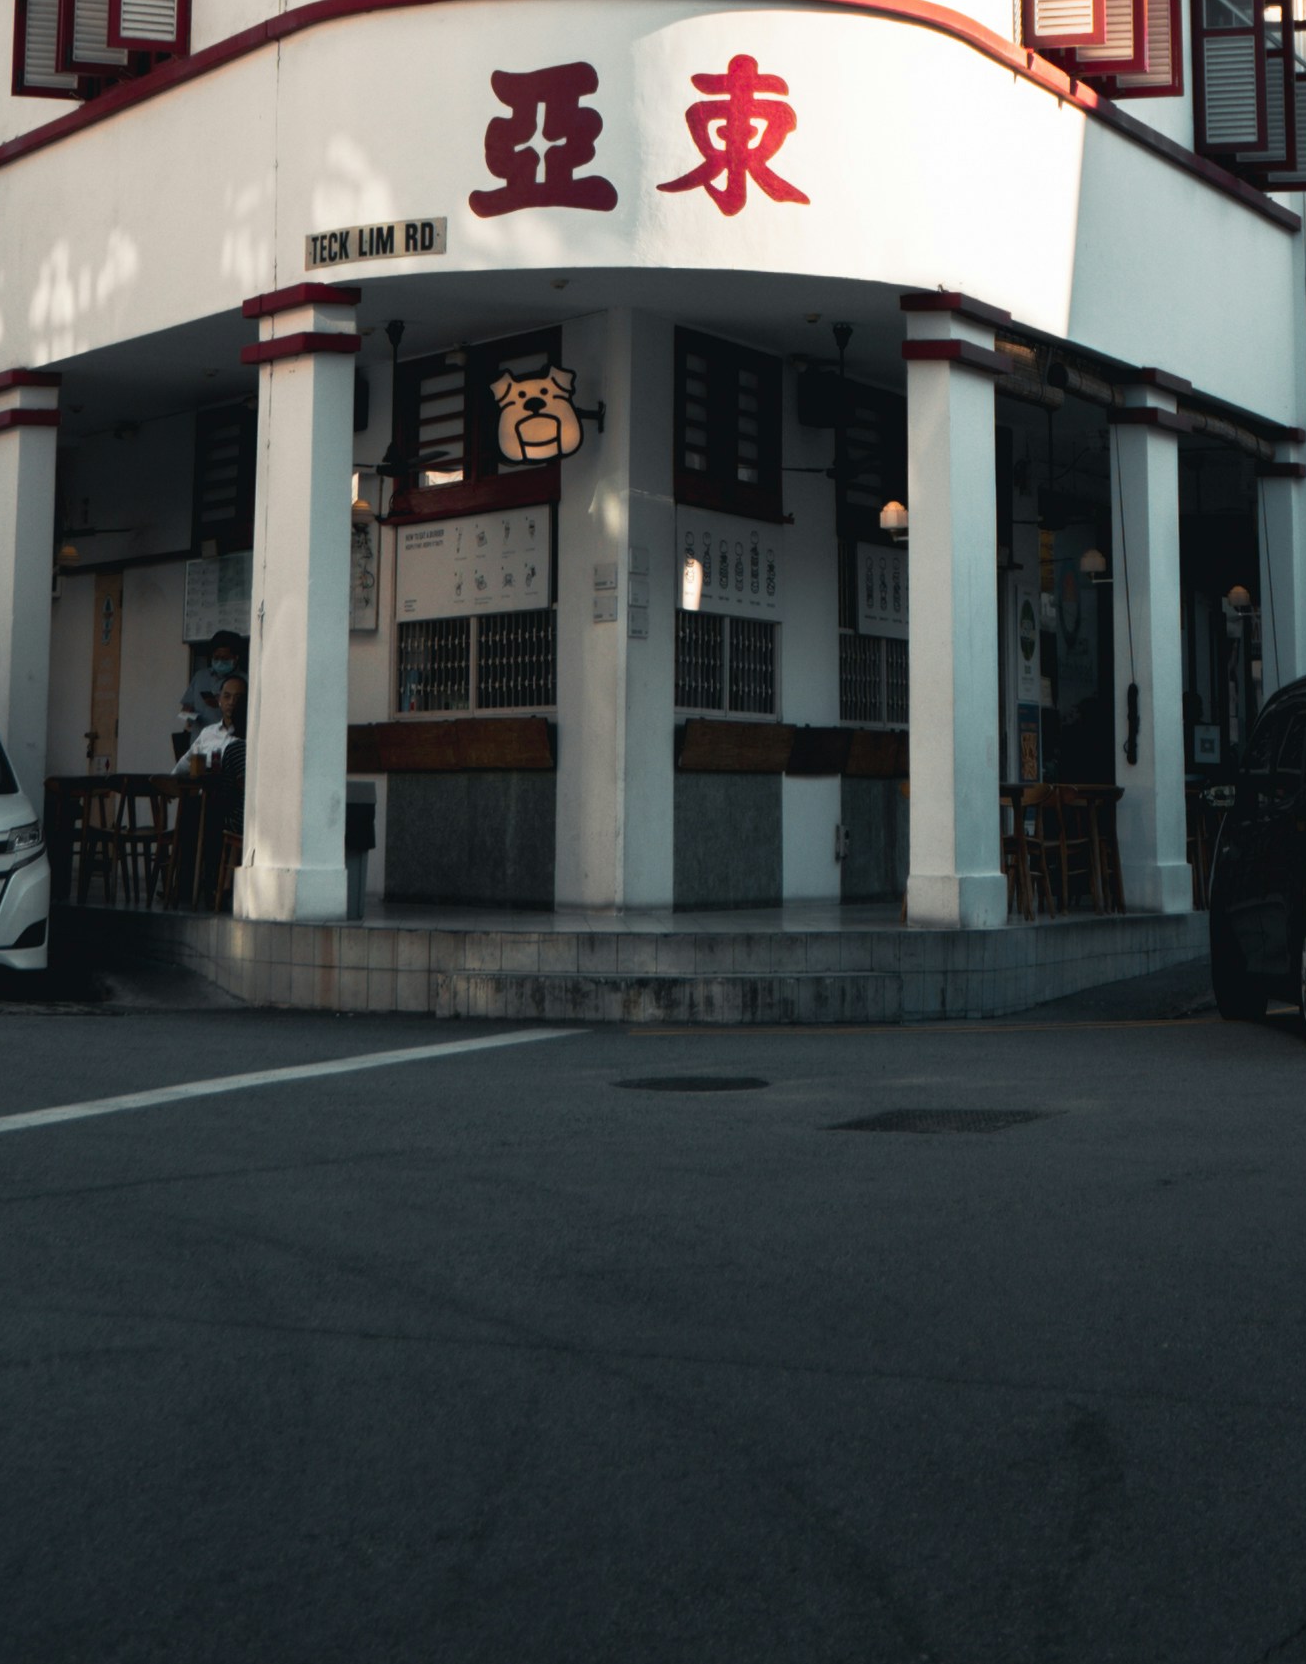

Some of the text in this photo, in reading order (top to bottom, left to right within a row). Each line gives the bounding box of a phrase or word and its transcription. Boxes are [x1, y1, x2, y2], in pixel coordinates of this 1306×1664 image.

[312, 222, 434, 264] TECK LIM RD
